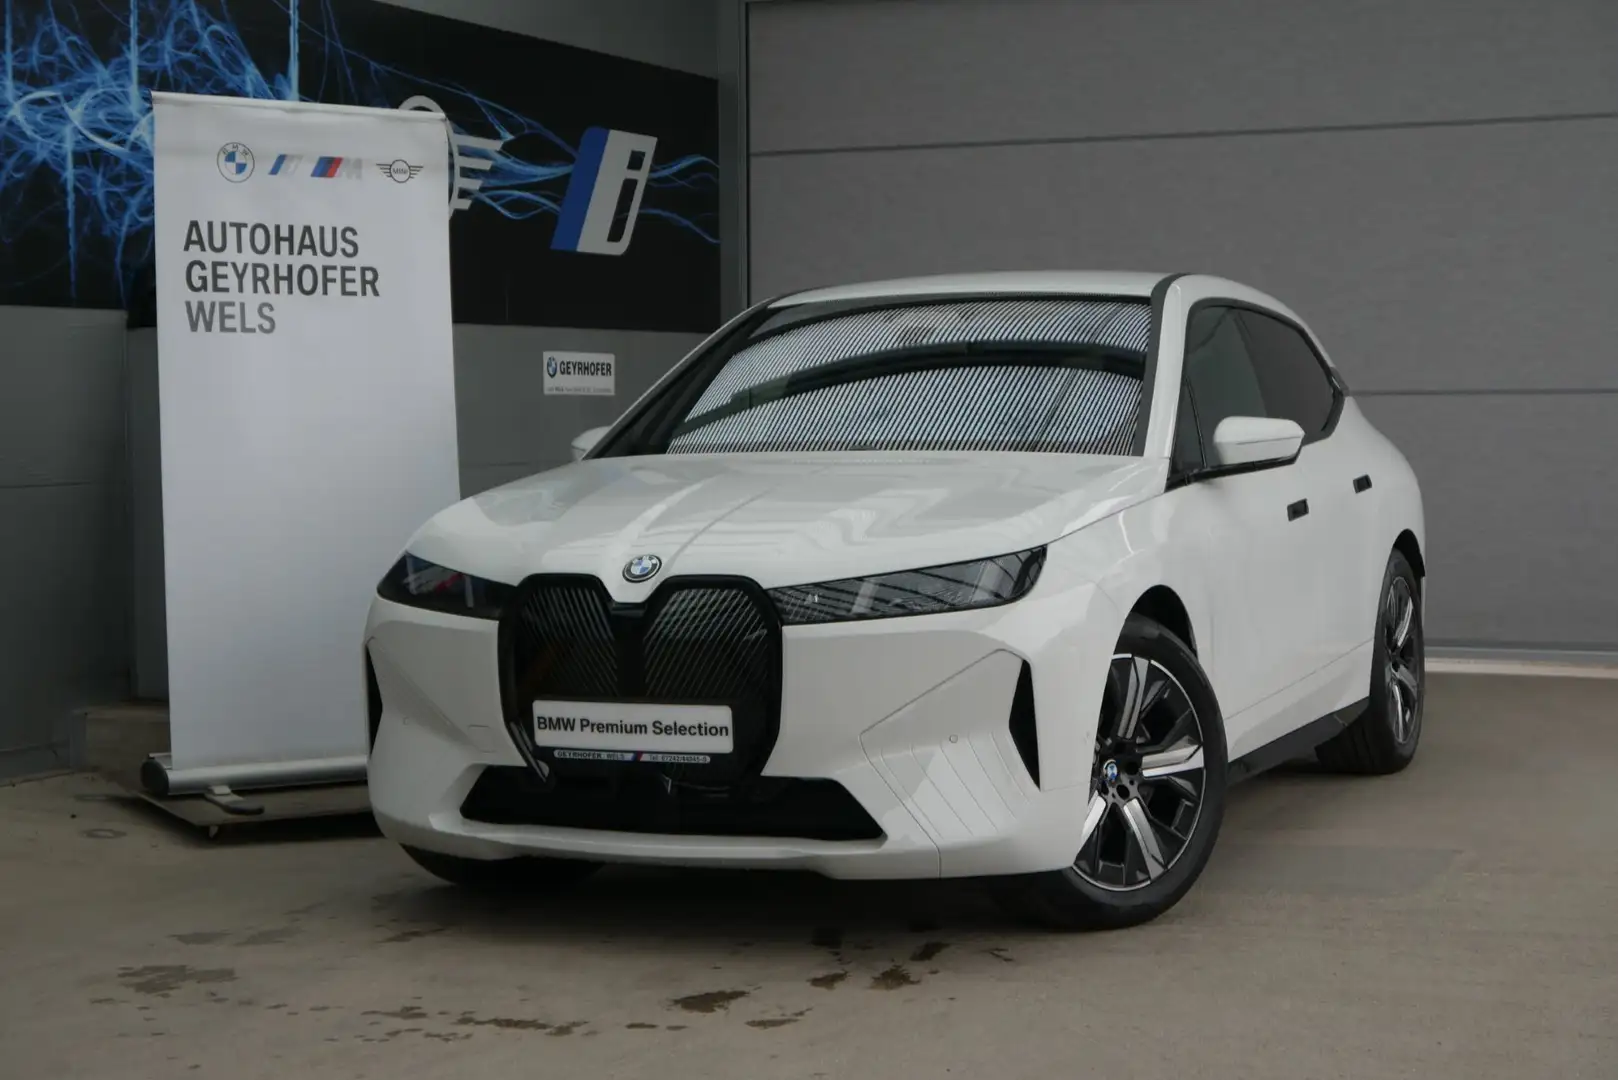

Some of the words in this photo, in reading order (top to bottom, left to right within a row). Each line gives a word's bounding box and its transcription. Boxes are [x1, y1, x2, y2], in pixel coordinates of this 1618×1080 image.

[183, 220, 360, 258] AUTOHAUS
[185, 259, 380, 297] GEYRHOFER
[185, 300, 276, 334] WELS
[559, 360, 612, 377] GEYRHOFER
[537, 716, 576, 732] BMW
[580, 718, 648, 735] Premium
[652, 720, 729, 737] Selection
[557, 750, 602, 759] GEYRHOFER
